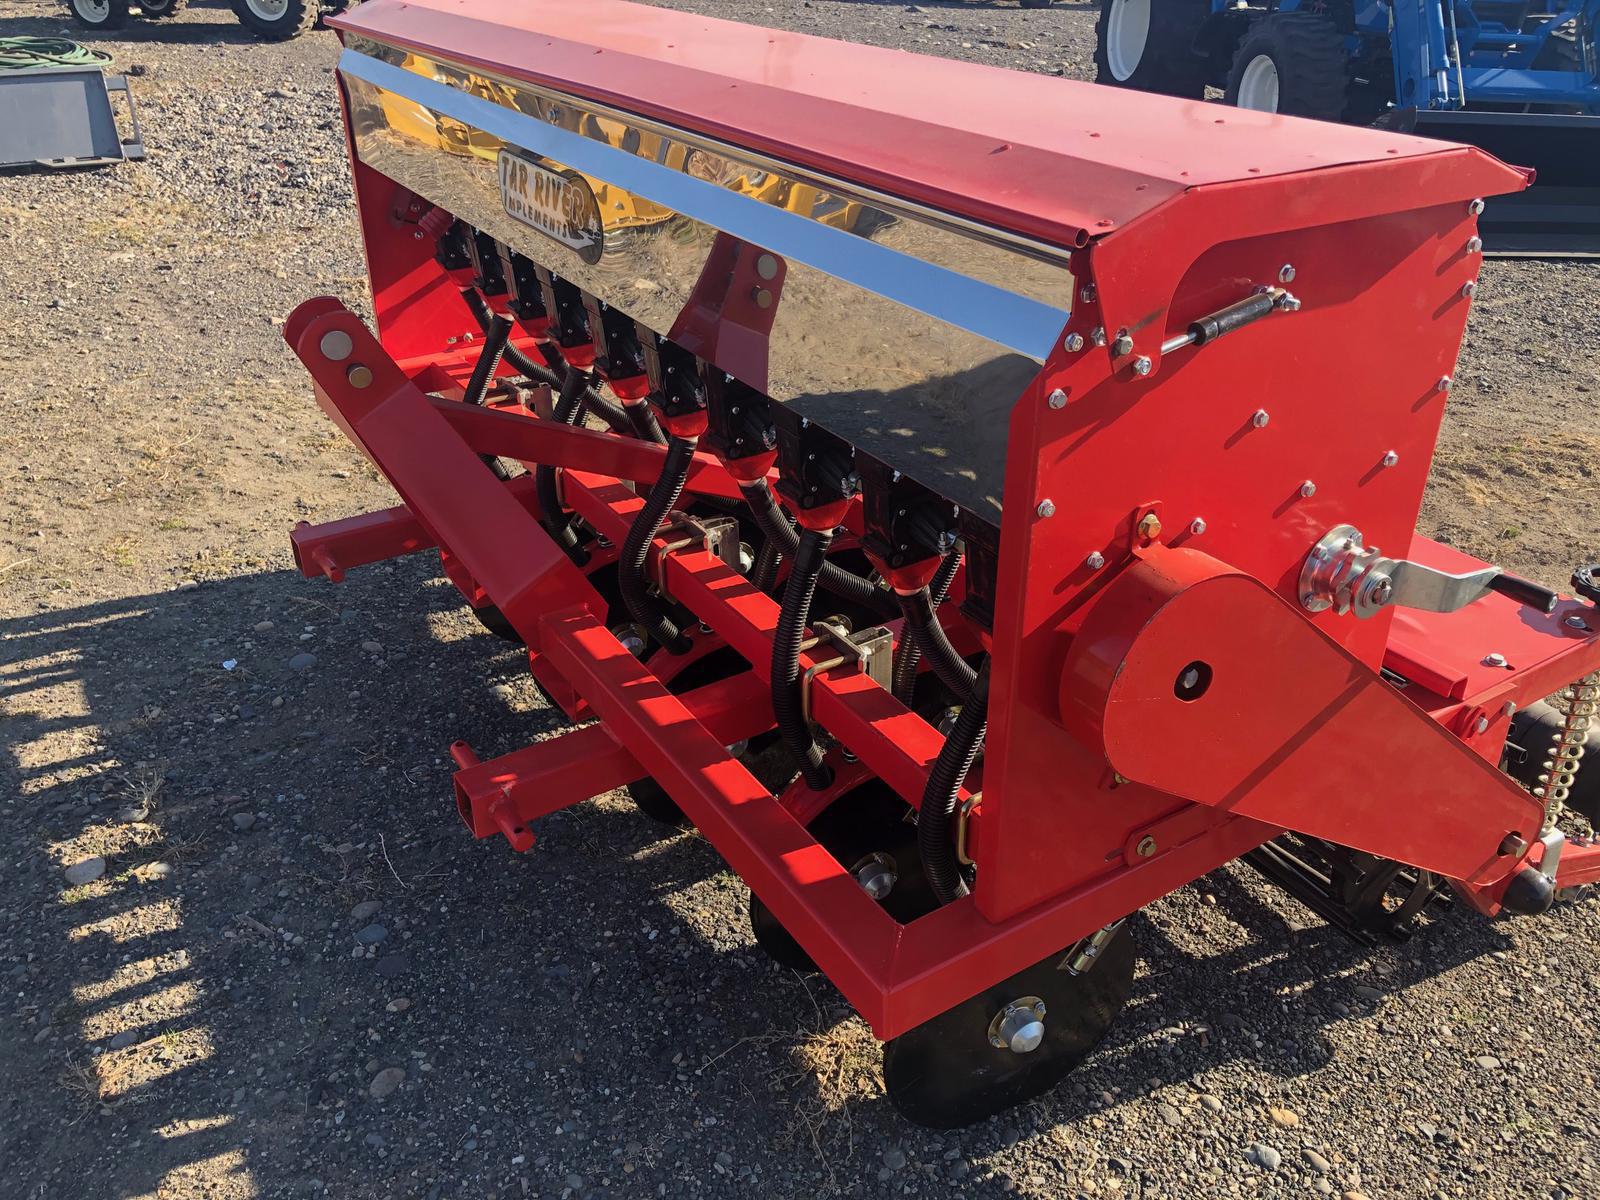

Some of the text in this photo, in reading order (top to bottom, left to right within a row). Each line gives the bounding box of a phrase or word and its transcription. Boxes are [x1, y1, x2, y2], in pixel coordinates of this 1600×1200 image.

[502, 156, 584, 229] TAR RIVER
[503, 188, 568, 238] IMPLEMENTS
